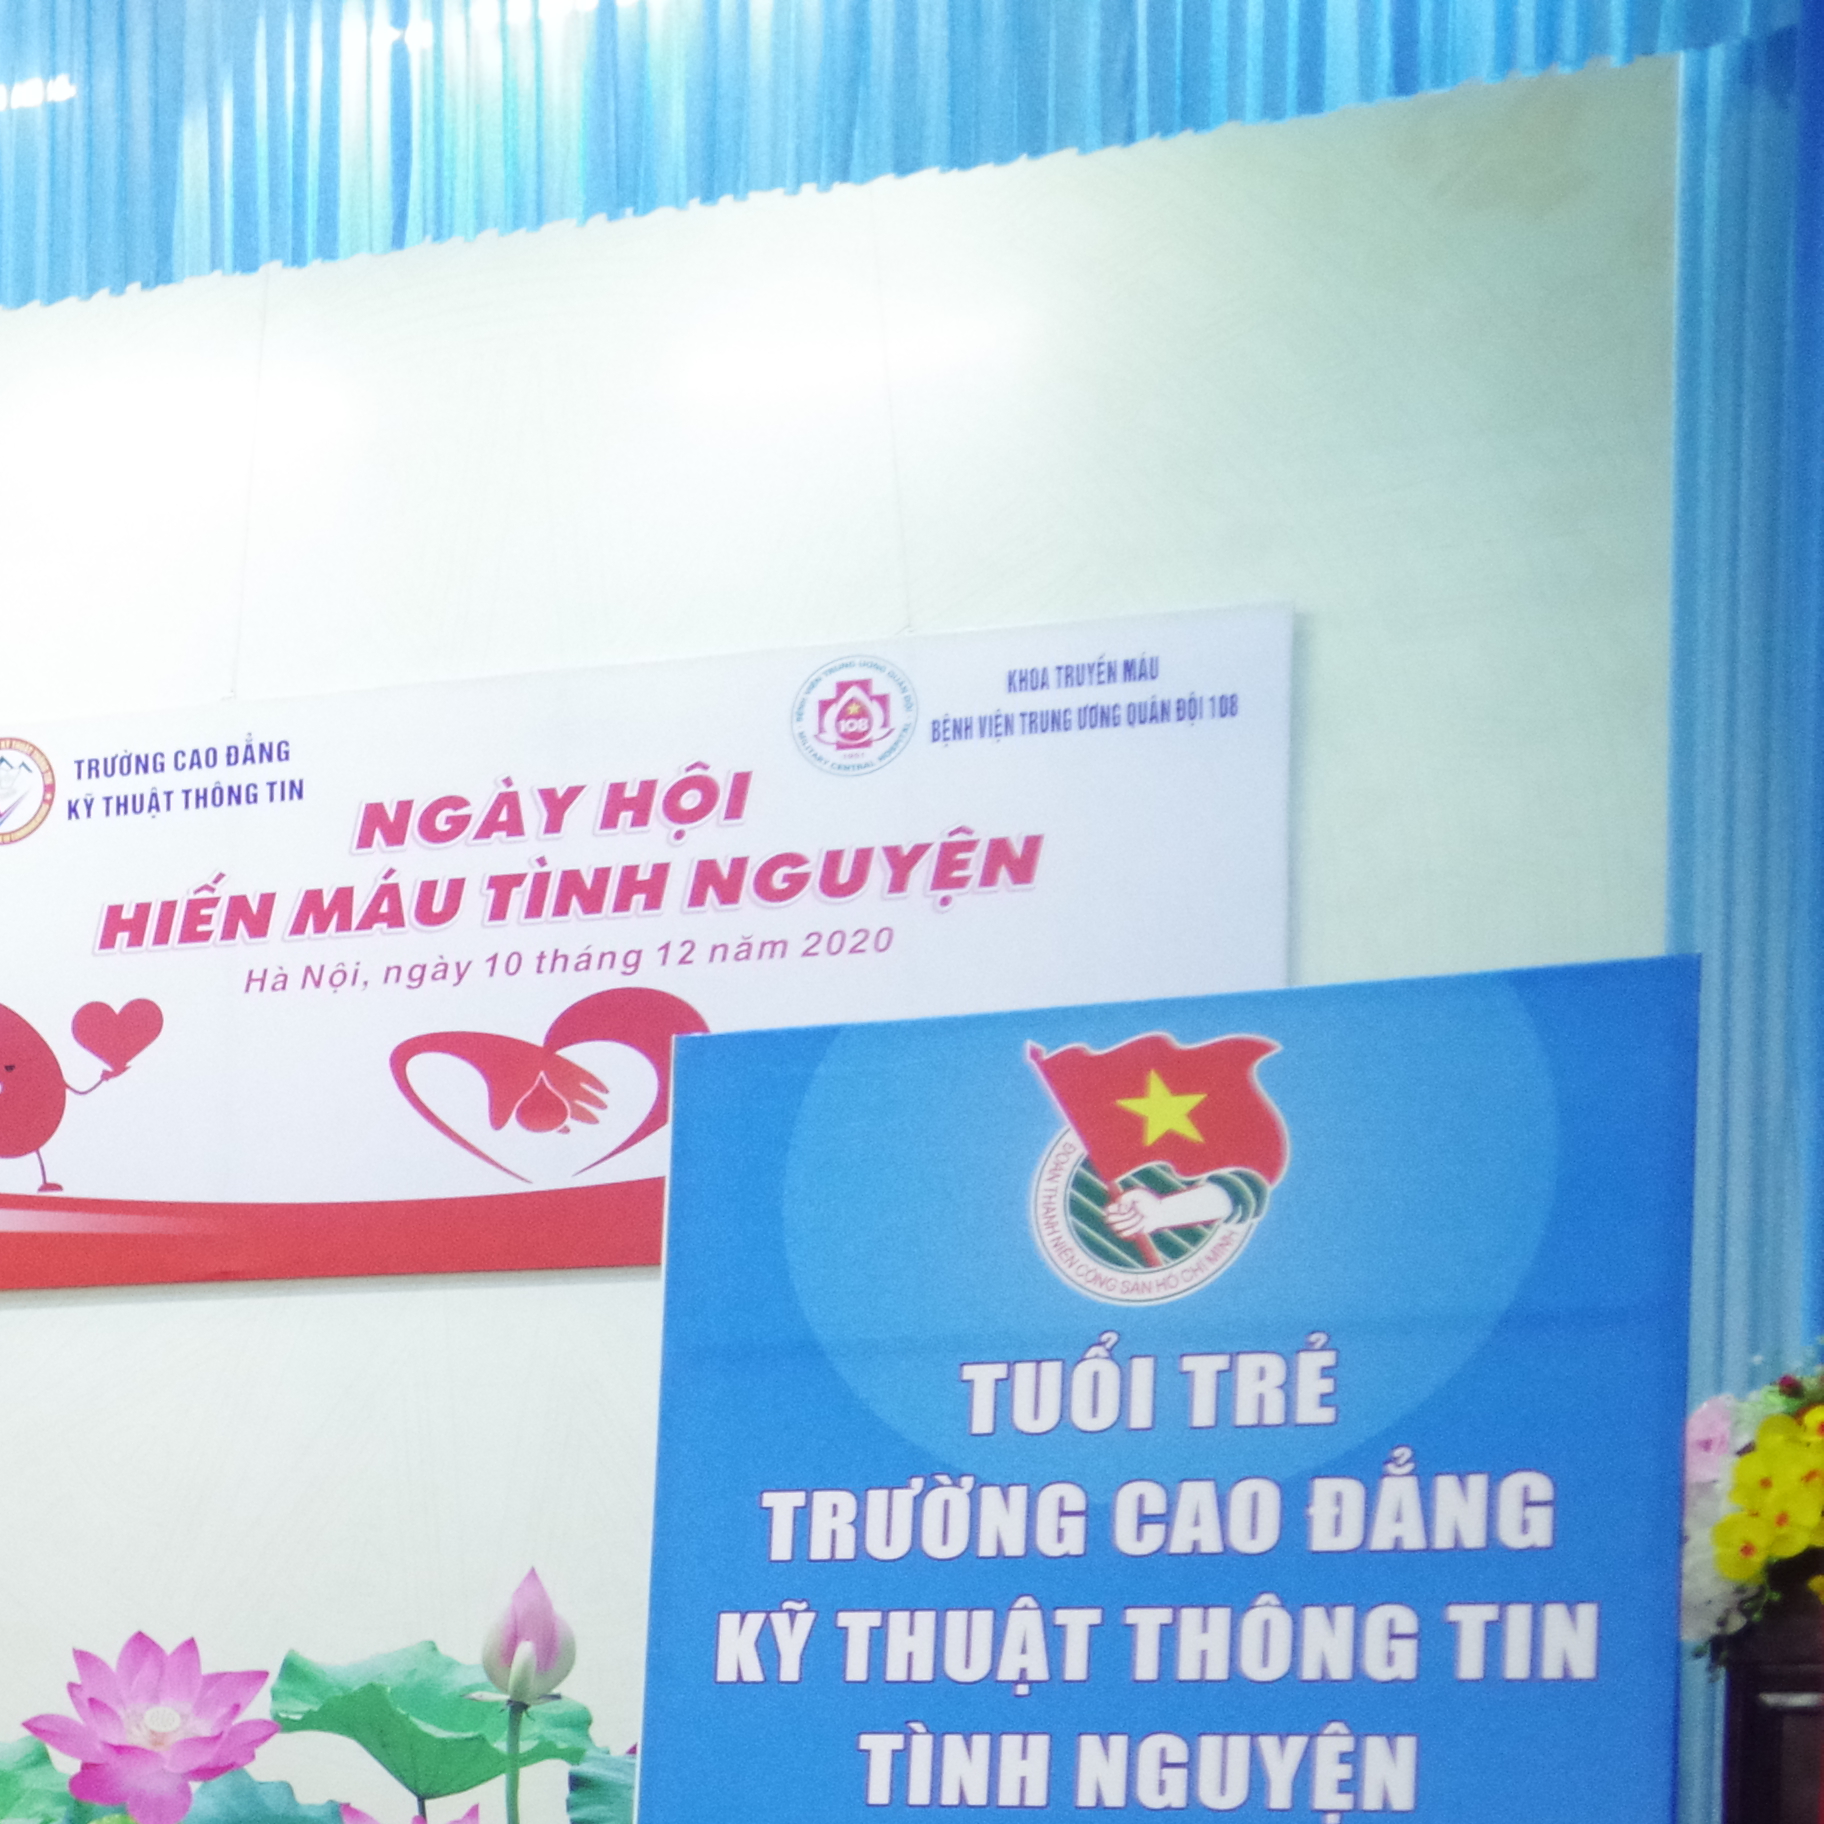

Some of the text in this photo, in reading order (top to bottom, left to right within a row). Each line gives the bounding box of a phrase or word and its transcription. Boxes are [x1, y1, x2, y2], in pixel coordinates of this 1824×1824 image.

[1007, 666, 1050, 694] KHOA
[1122, 652, 1160, 682] MÁU
[74, 732, 291, 781] TRƯỜNG CAO ĐẲNG
[839, 718, 870, 733] 108
[931, 691, 1240, 748] BỆNH VIỆN TRUNG ƯƠNG QUÂN ĐỘI 108
[67, 778, 304, 821] KỸ THUẬT THÔNG TIN
[355, 760, 753, 851] NGÀY HỘI
[95, 823, 1046, 953] HIẾN MÁU TÌNH NGUYỆN
[243, 924, 896, 996] Hà Nội, ngày 10 tháng 12 năm 2020
[959, 1330, 1339, 1437] TUỔI TRẺ
[760, 1447, 1555, 1563] TRƯỜNG CAO ĐẲNG
[714, 1592, 1600, 1698] KỸ THUẬT THÔNG TIN
[857, 1721, 1050, 1808] TÌNH
